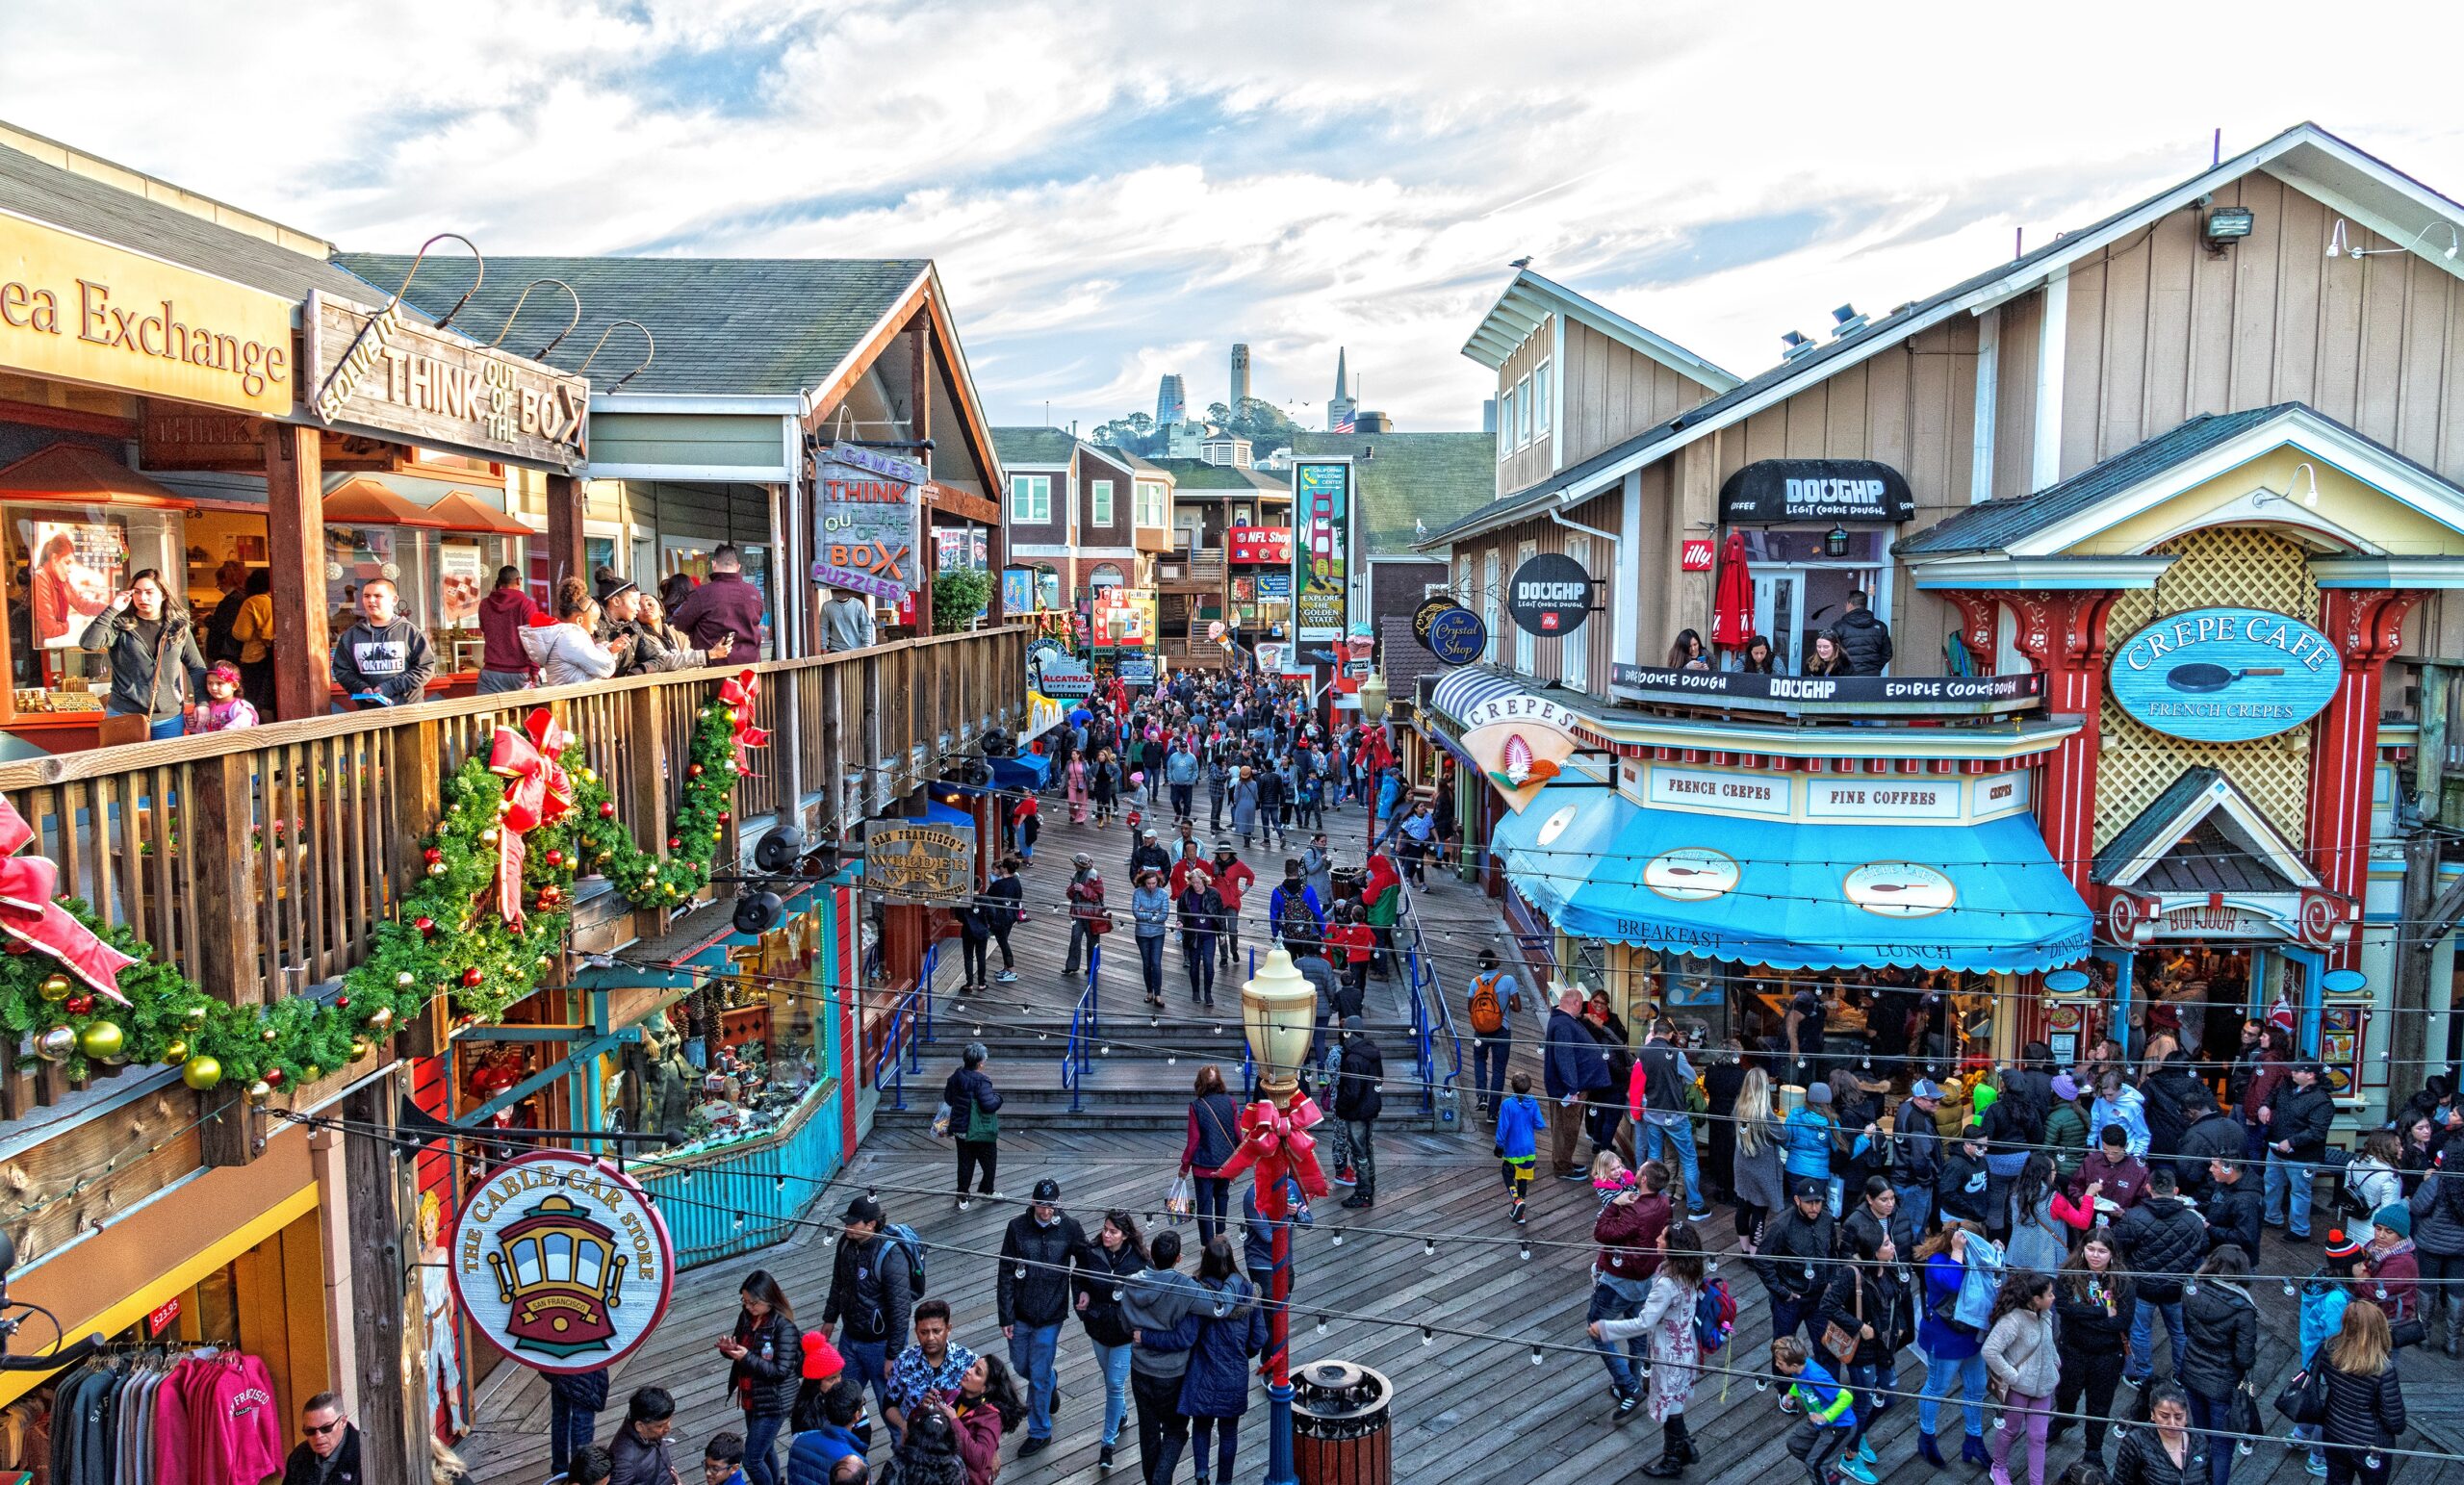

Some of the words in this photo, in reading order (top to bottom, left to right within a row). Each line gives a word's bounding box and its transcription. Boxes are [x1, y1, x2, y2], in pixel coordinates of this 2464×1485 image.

[0, 280, 63, 335] ea
[76, 277, 288, 397] Exchange
[319, 336, 387, 420] SOLVE
[380, 346, 481, 422] THINK
[483, 359, 521, 392] OUT
[489, 387, 514, 417] OF
[518, 384, 590, 444] BOX
[160, 417, 251, 444] THINK
[485, 414, 519, 443] THE
[839, 445, 915, 480] GAMES
[826, 480, 909, 504] THINK
[1785, 478, 1886, 504] DOUGHP
[1730, 501, 1757, 511] COFFEE
[1785, 503, 1815, 515] LEGIT
[1816, 504, 1848, 515] COOKIE
[825, 508, 863, 532] OUT
[876, 508, 910, 536] THE
[855, 526, 879, 541] OF
[1247, 531, 1267, 543] NFL
[1269, 530, 1291, 546] Shop
[831, 540, 910, 580] BOX
[1683, 544, 1712, 568] illy
[813, 564, 900, 601] PUZZLES
[1518, 581, 1585, 601] DOUGHP
[1436, 623, 1479, 640] Crystal
[1451, 616, 1464, 625] The
[1543, 616, 1556, 627] illy
[1442, 640, 1473, 660] Shop
[2127, 615, 2237, 672] CRÊPE
[2245, 616, 2332, 673] CAFE
[1352, 660, 1368, 670] eyer's
[1637, 670, 1678, 685] COOKIE
[1681, 676, 1727, 691] DOUGH
[1769, 678, 1836, 699] DOUGHP
[1886, 682, 1941, 696] EDIBLE
[1946, 682, 1993, 698] COOKIE
[1994, 680, 2016, 695] DOUGH
[1470, 699, 1575, 727] CREPES
[2147, 702, 2220, 717] FRENCH
[2226, 704, 2294, 719] CREPES
[1668, 779, 1717, 795] FRENCH
[1722, 783, 1771, 801] CREPES
[1831, 790, 1865, 805] FINE
[1873, 790, 1937, 806] COFFEES
[1989, 783, 2013, 800] CREPES
[871, 832, 892, 847] SAN
[898, 830, 966, 853] FRANCISCO'S
[868, 854, 969, 872] WILDER
[884, 869, 953, 884] WEST
[1616, 918, 1725, 949] BREAKFAST
[1874, 944, 1953, 960] LUNCH
[2049, 932, 2085, 960] DINNER
[472, 1165, 558, 1223] CABLE
[566, 1168, 625, 1214] CAR
[463, 1228, 483, 1275] THE
[620, 1211, 654, 1280] STORE
[154, 1299, 178, 1326] $23.95
[532, 1298, 547, 1311] SAN
[547, 1297, 587, 1312] FRANCISCO
[234, 1388, 270, 1407] FRACISCO
